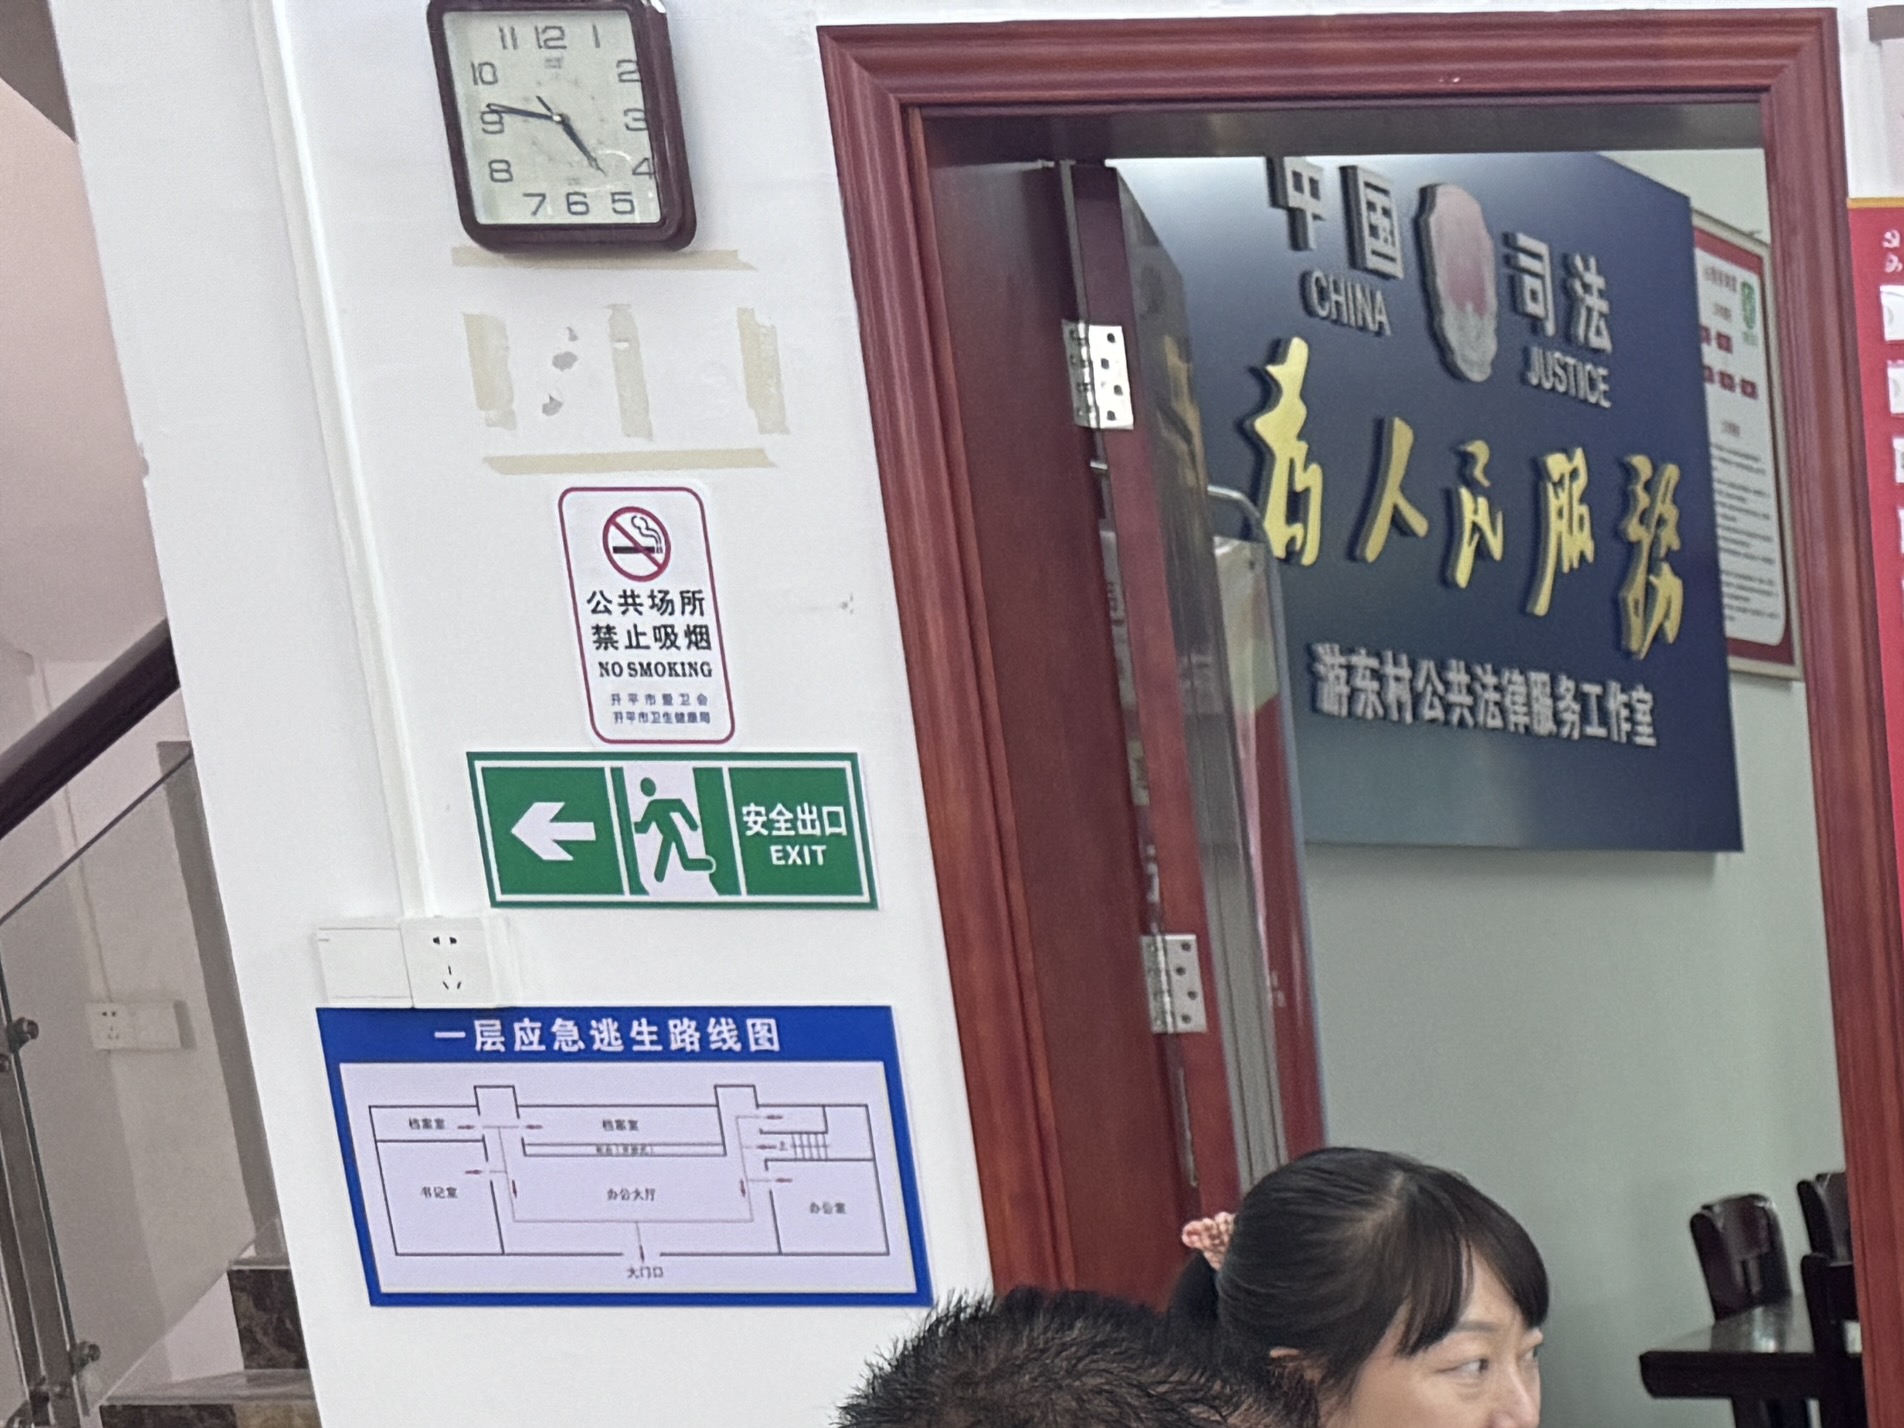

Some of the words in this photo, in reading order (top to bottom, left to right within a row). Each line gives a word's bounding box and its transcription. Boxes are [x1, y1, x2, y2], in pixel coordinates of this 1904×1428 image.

[499, 25, 518, 50] 11
[534, 25, 567, 50] 12
[592, 23, 600, 48] 1
[471, 61, 498, 86] 10
[616, 58, 642, 83] 2
[480, 108, 505, 134] 9
[623, 108, 649, 132] 3
[488, 159, 513, 183] 8
[631, 157, 656, 179] 4
[522, 192, 546, 216] 7
[565, 191, 590, 215] 6
[610, 191, 635, 215] 5
[1275, 156, 1404, 280] 中国
[1503, 231, 1613, 354] 司法
[1307, 269, 1392, 337] CHINA
[1526, 345, 1612, 408] JUSTICE
[586, 589, 706, 617] 公共场所
[590, 623, 712, 651] 禁止吸烟
[598, 661, 624, 678] NO
[627, 661, 713, 678] SMOKING
[1310, 641, 1657, 748] 游东村公共法律服务工作室
[741, 802, 848, 836] 安全出口
[769, 844, 827, 866] EXIT
[434, 1016, 781, 1053] 一层应急逃生路线图
[420, 1186, 458, 1199] 书记室
[606, 1187, 656, 1202] 办公大厅
[809, 1201, 846, 1215] 办公室
[626, 1266, 664, 1280] 大门口
